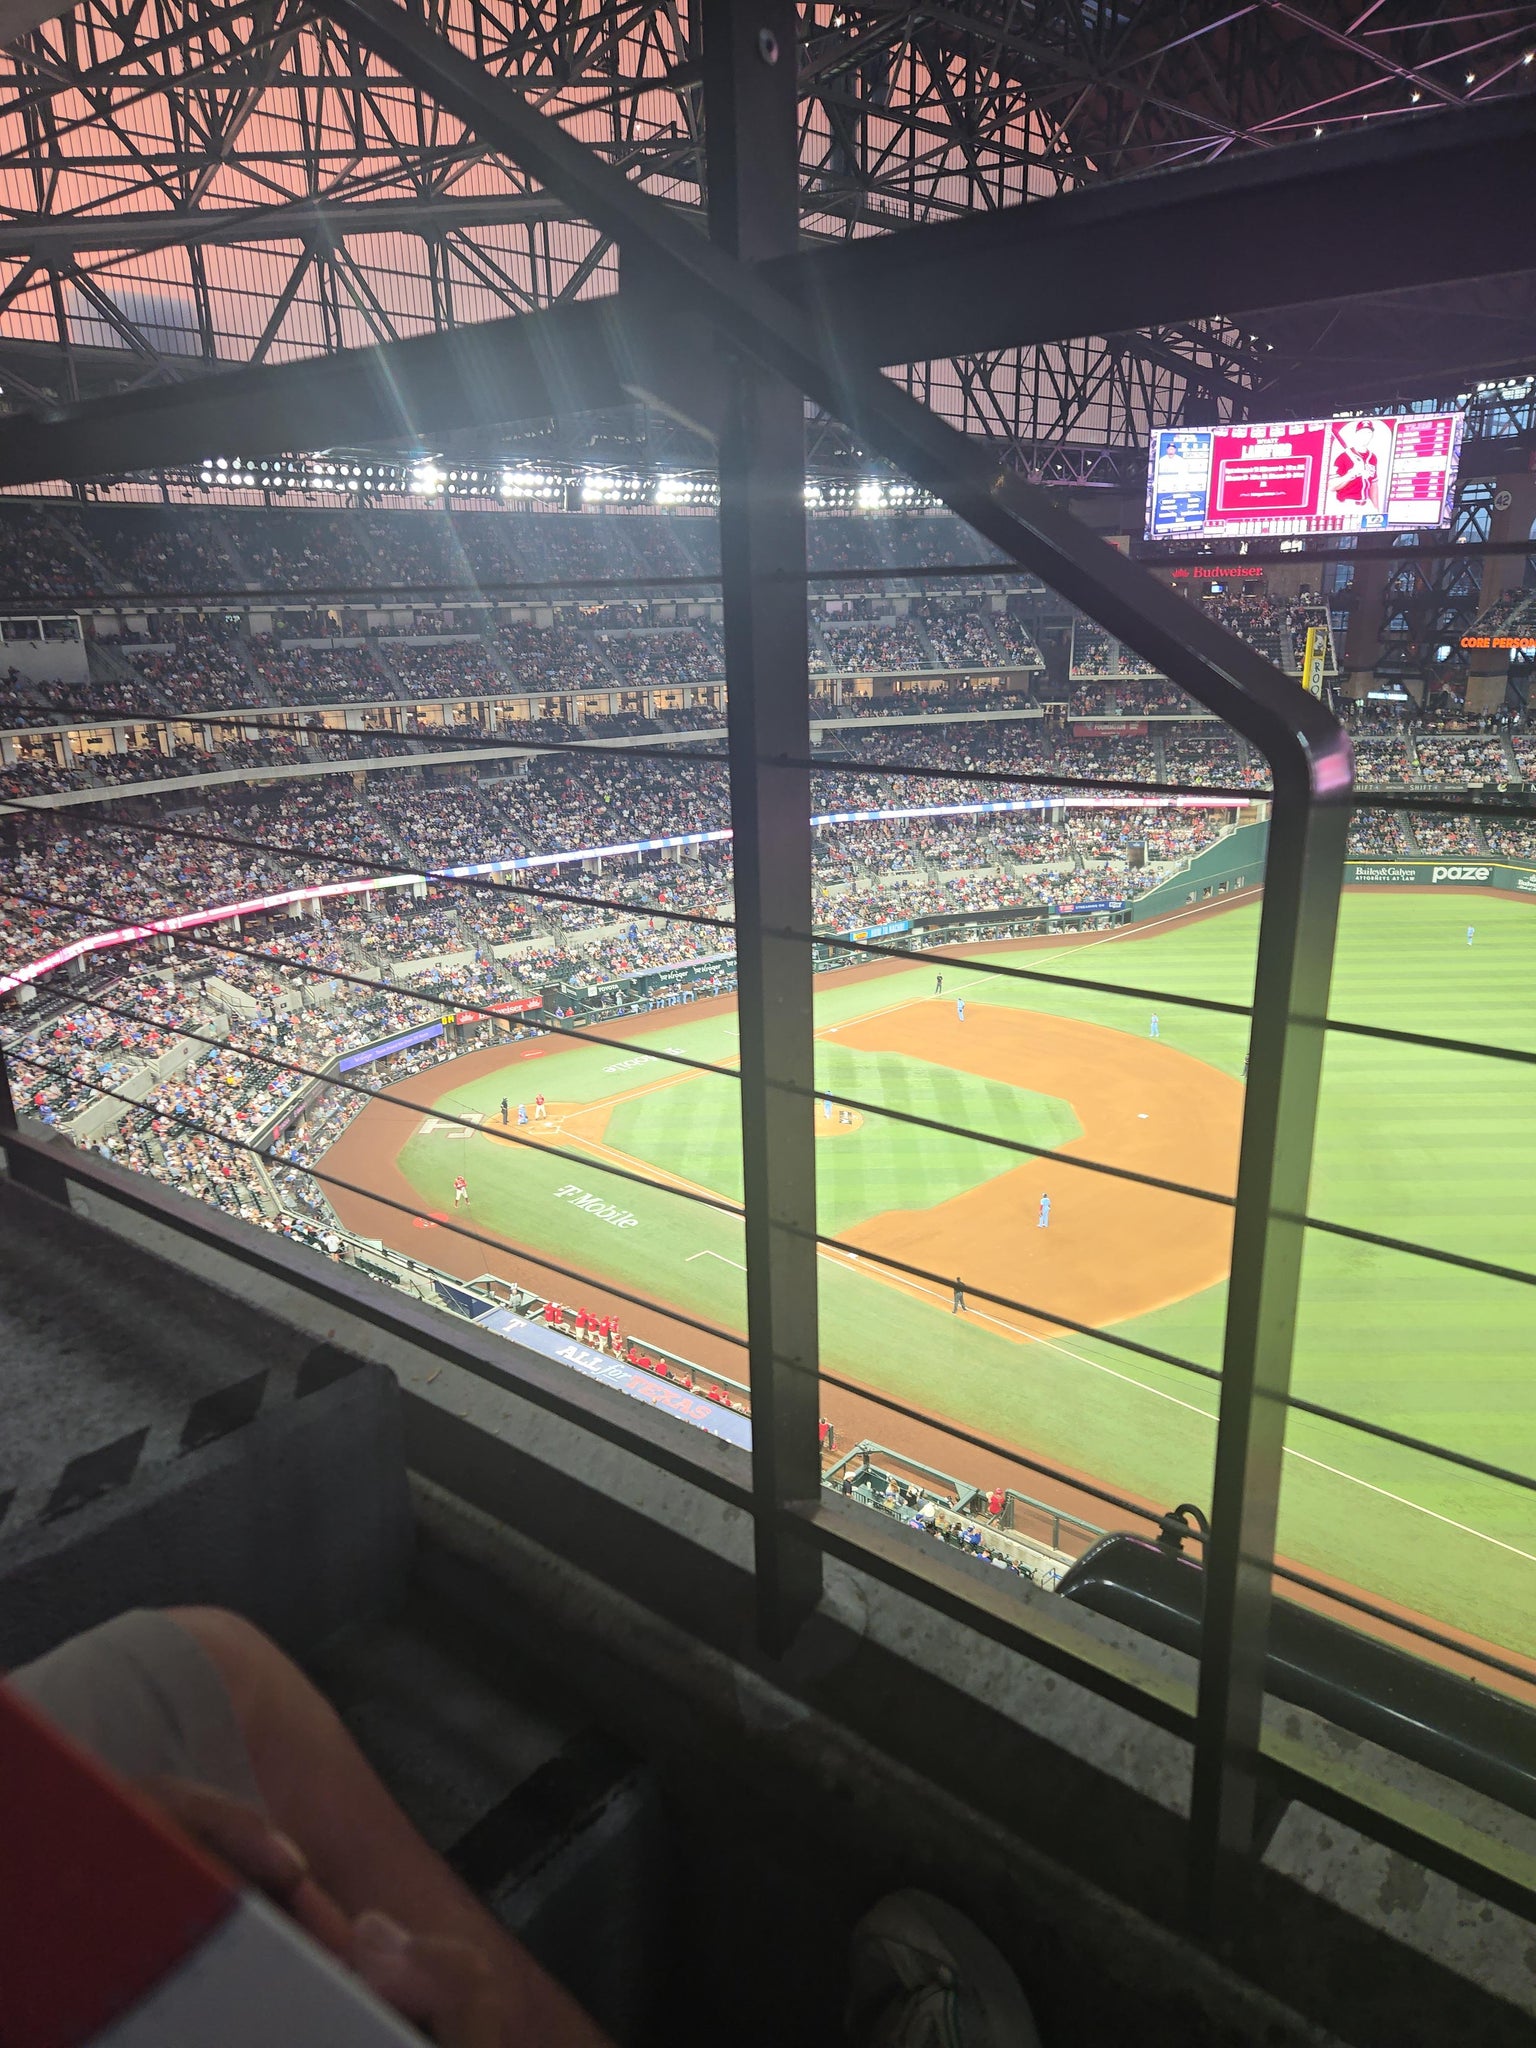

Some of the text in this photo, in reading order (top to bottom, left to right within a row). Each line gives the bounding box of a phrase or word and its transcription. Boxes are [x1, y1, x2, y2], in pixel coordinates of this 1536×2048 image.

[1496, 494, 1509, 506] 42
[1193, 566, 1263, 578] Budweiser
[1460, 637, 1491, 648] CORE
[1432, 866, 1490, 883] paze
[701, 963, 721, 975] Kroger
[667, 970, 688, 981] Kroger
[598, 984, 620, 992] TOYOTA
[555, 1346, 603, 1371] ALL
[626, 1374, 712, 1420] TEXAS
